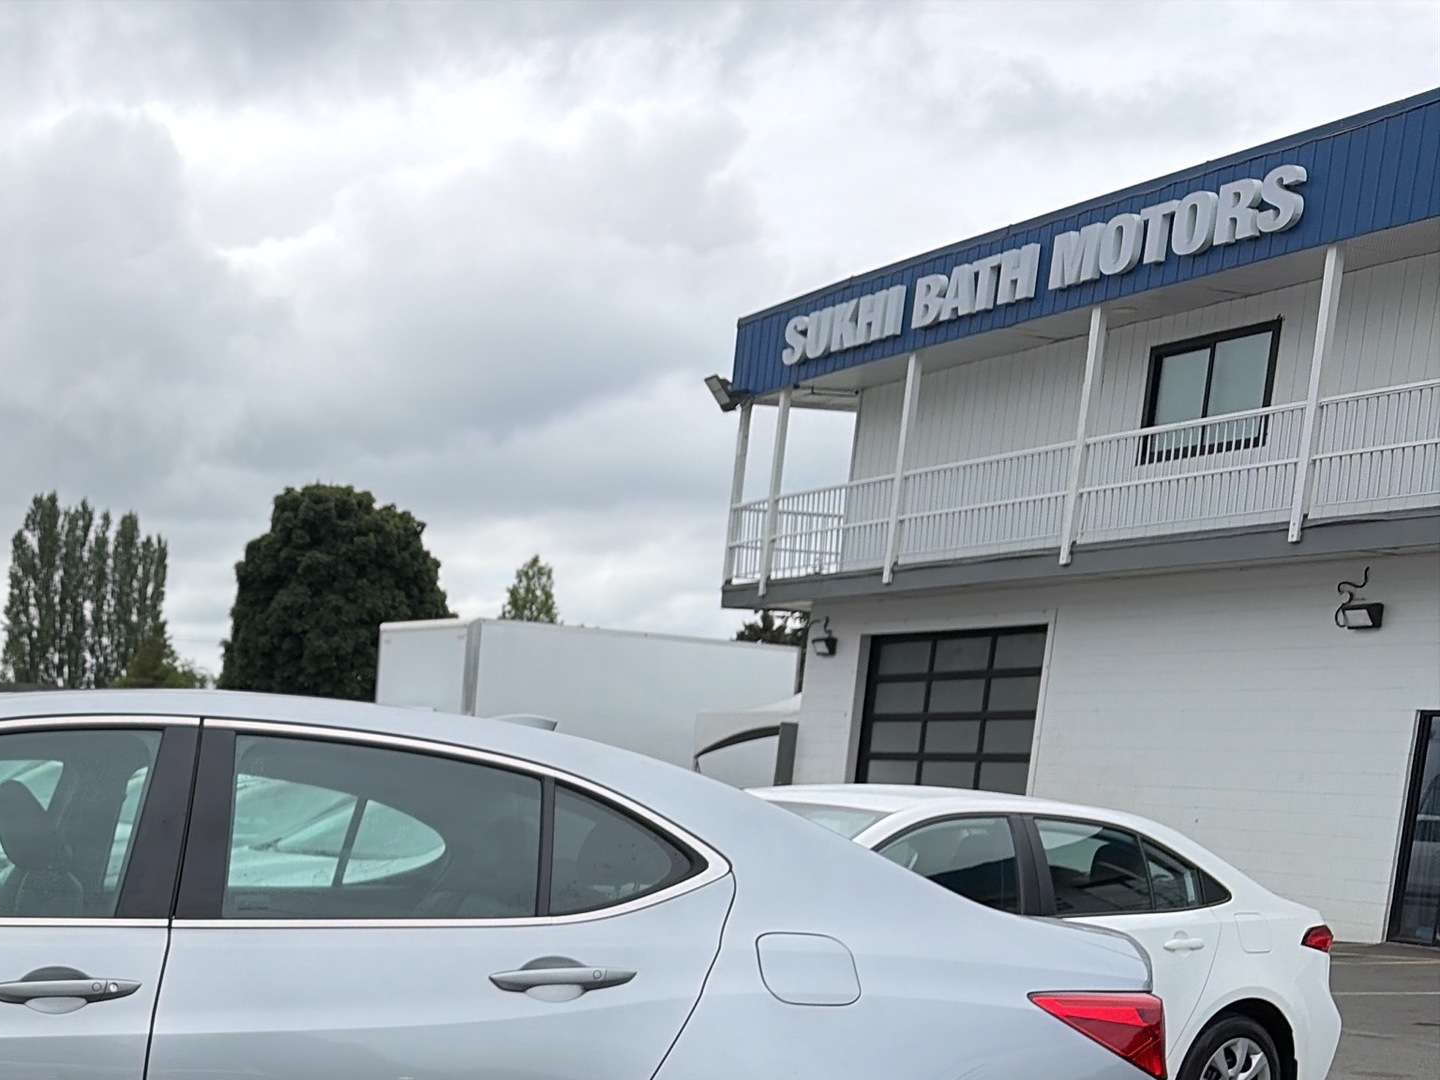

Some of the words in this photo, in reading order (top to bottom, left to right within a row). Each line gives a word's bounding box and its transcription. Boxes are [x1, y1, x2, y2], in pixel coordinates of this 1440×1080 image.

[781, 284, 907, 367] SUKHI
[910, 243, 1041, 330] BATH
[1048, 164, 1308, 290] MOTORS
